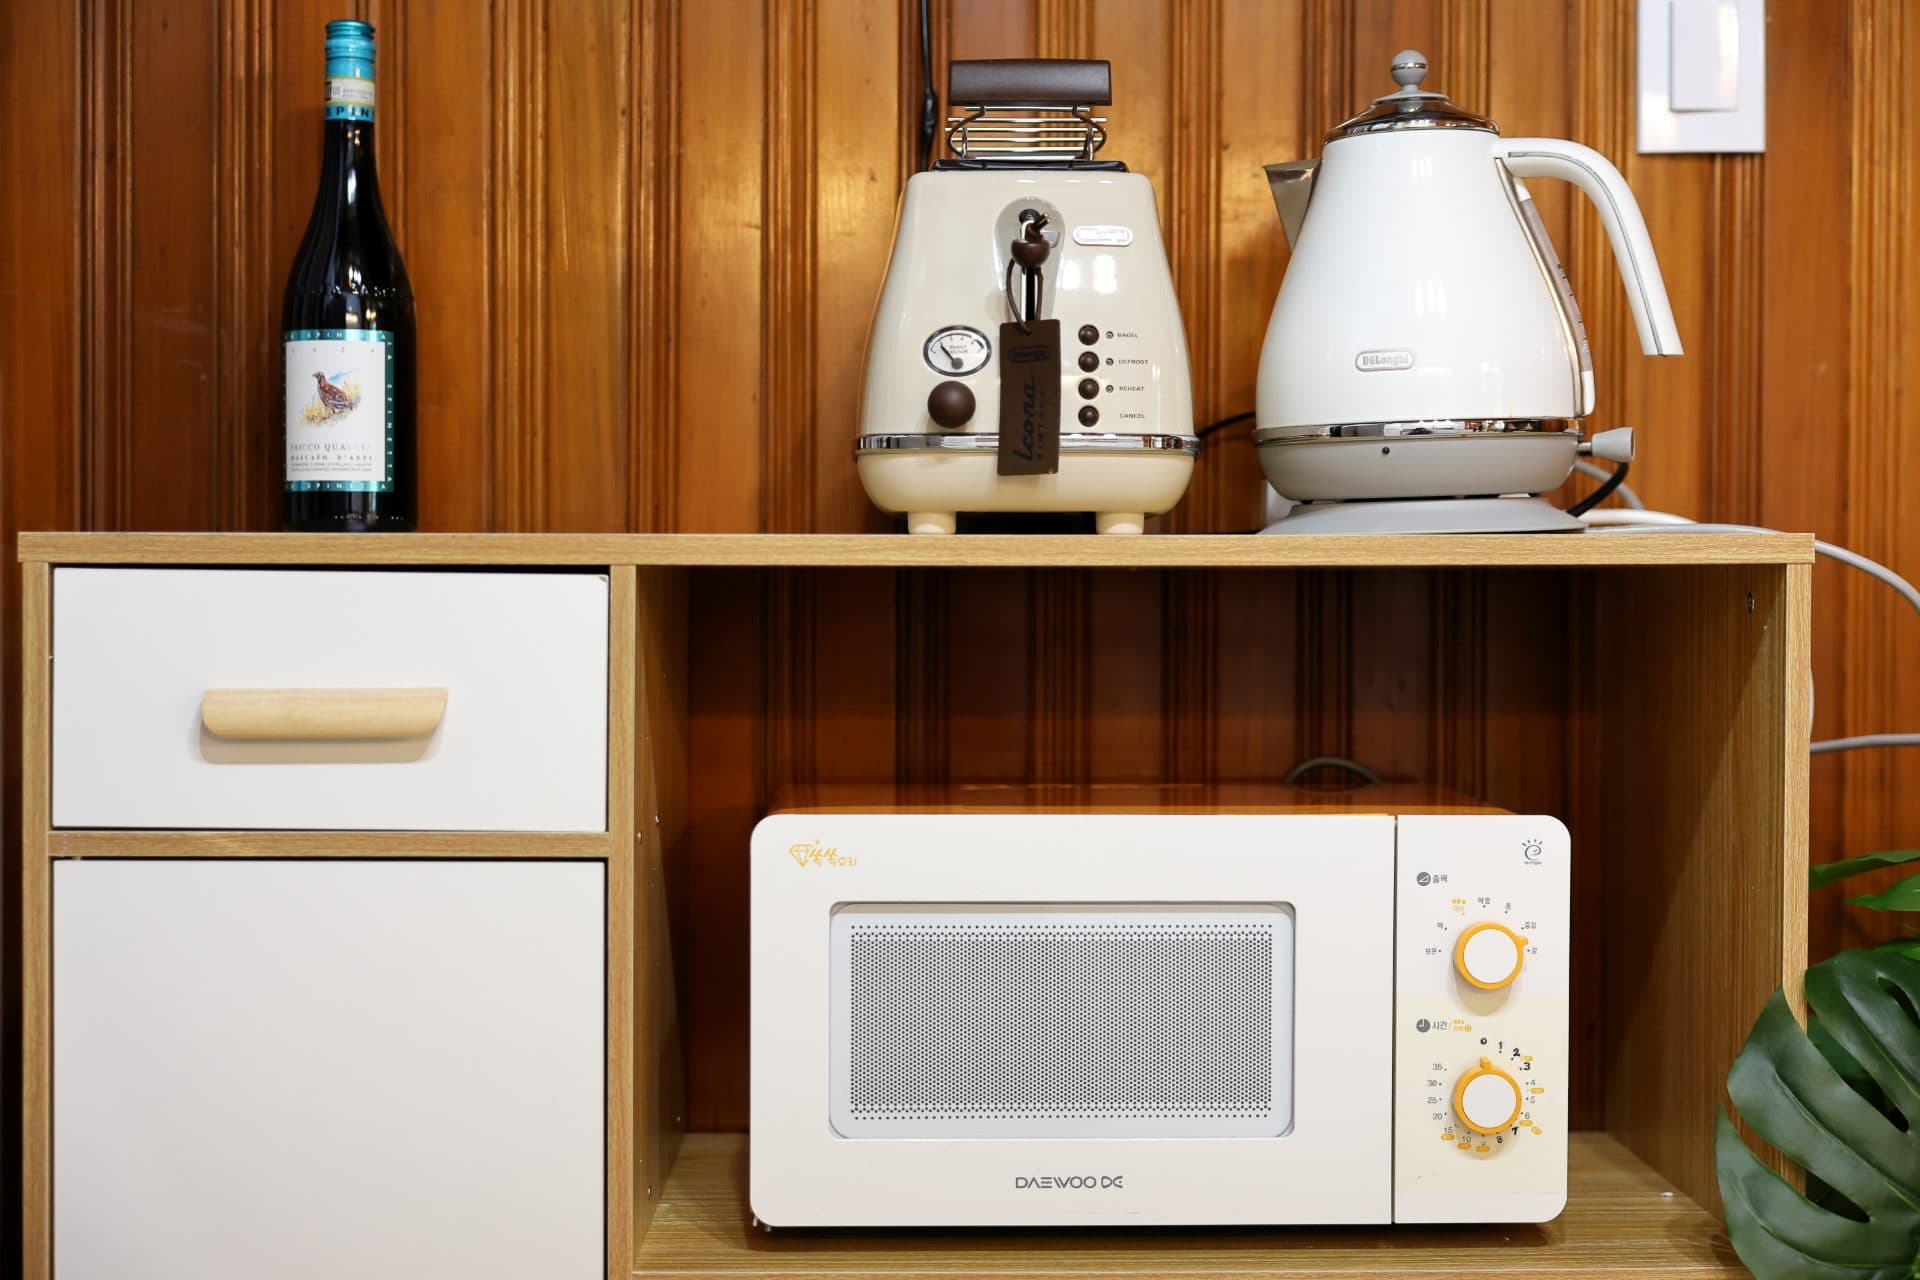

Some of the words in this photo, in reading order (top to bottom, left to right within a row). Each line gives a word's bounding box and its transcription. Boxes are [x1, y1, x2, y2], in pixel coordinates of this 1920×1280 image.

[1012, 373, 1037, 461] Icona
[1432, 1021, 1448, 1030] 시간
[1480, 1037, 1487, 1045] 0
[1499, 1041, 1503, 1049] 1
[1513, 1047, 1520, 1057] 2
[1432, 1063, 1442, 1071] 35
[1523, 1062, 1531, 1071] 3
[1427, 1079, 1437, 1087] 30
[1427, 1096, 1437, 1104] 25
[1530, 1095, 1536, 1104] 5
[1432, 1112, 1442, 1120] 20
[1524, 1111, 1530, 1120] 6
[1444, 1126, 1453, 1134] 15
[1511, 1126, 1519, 1135] 7
[1461, 1135, 1471, 1143] 10
[1496, 1135, 1503, 1144] 8
[1015, 1175, 1097, 1189] DAEWOO
